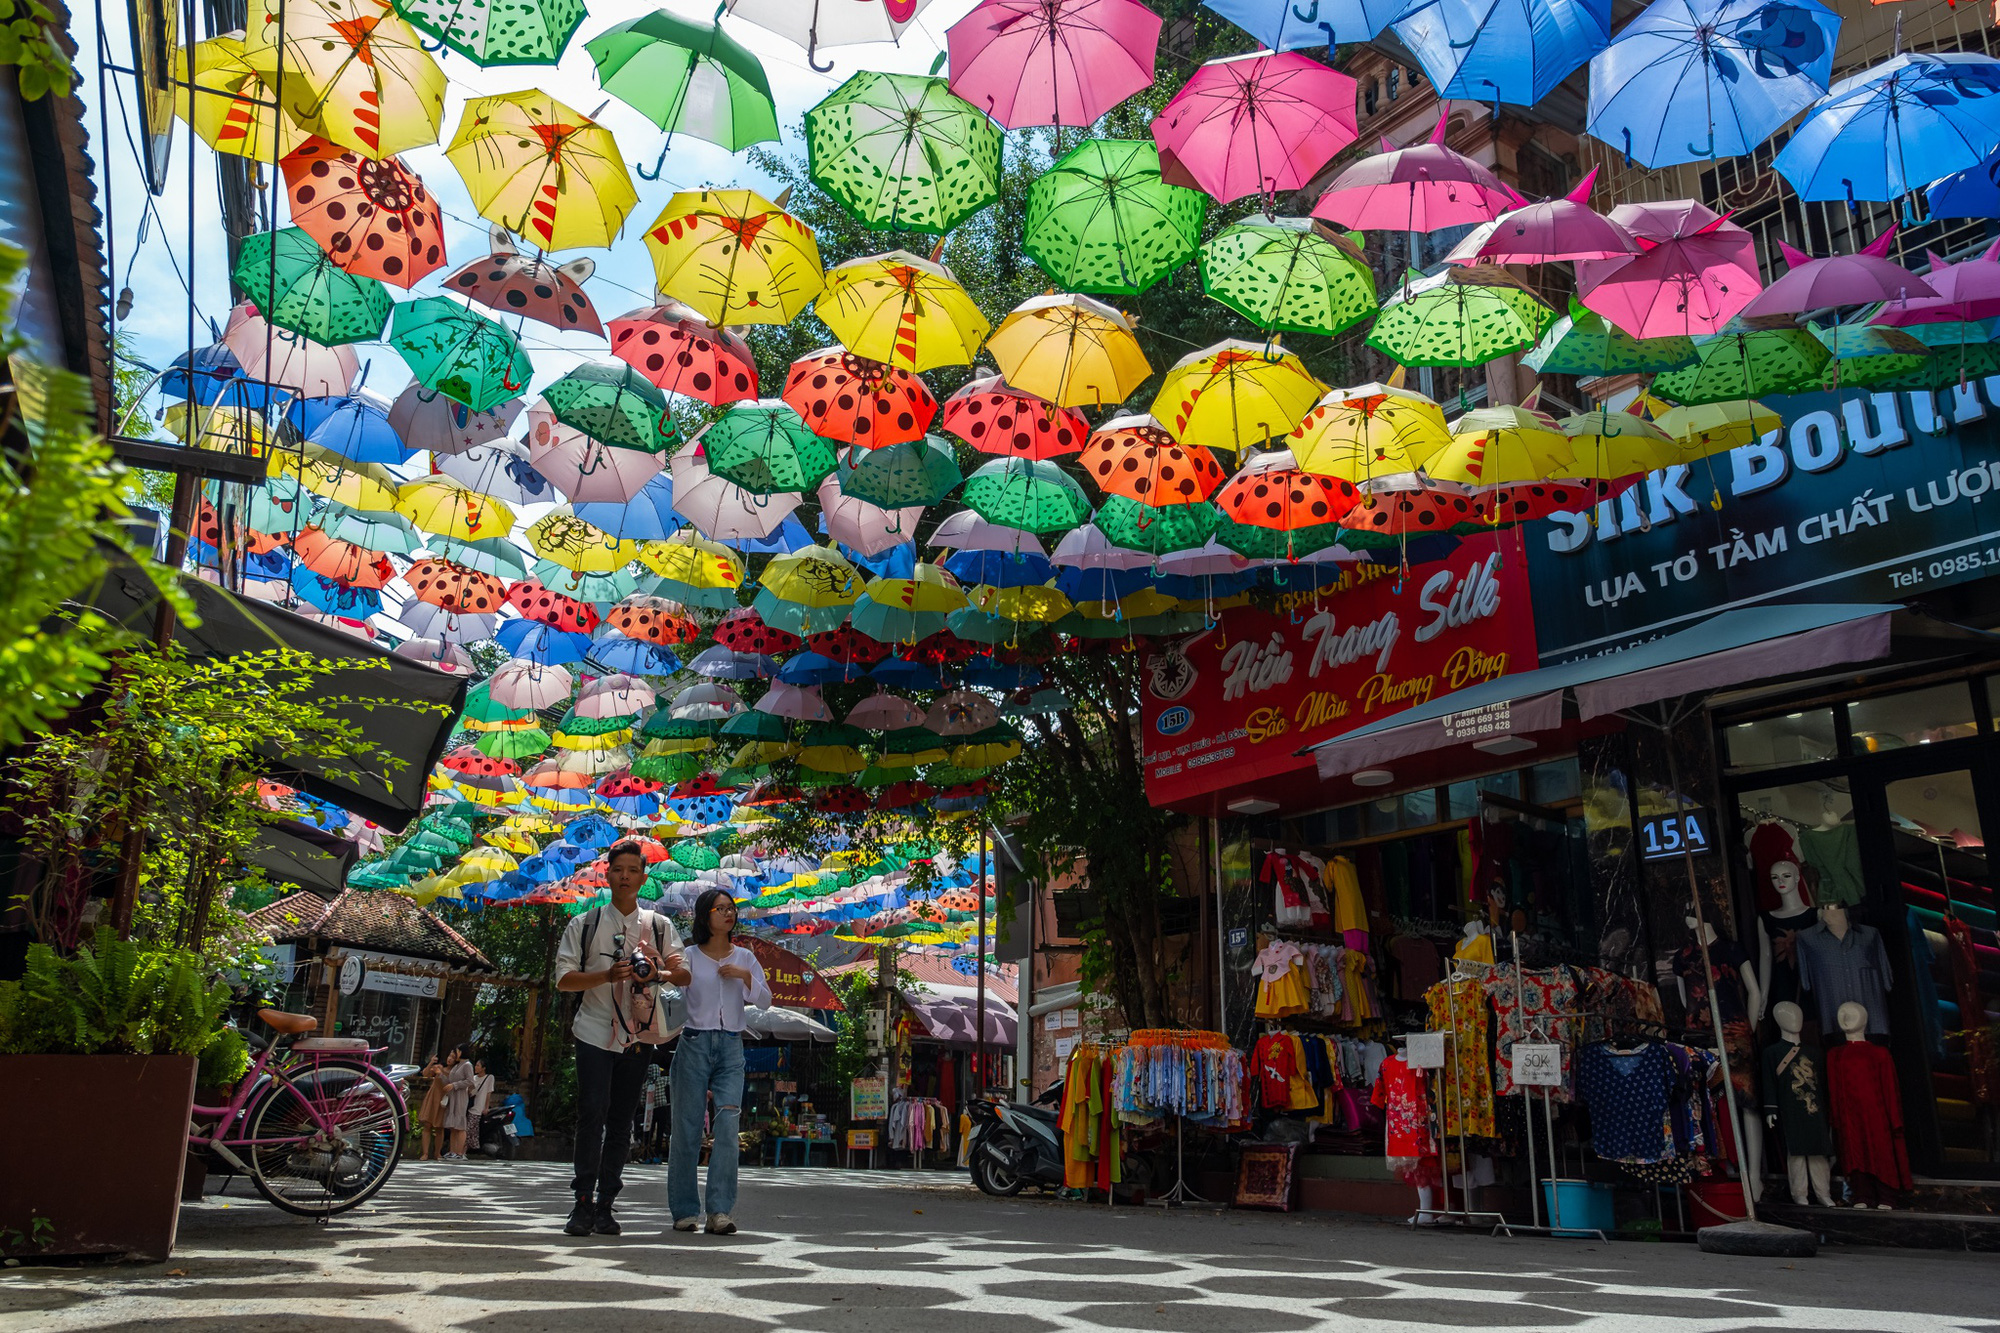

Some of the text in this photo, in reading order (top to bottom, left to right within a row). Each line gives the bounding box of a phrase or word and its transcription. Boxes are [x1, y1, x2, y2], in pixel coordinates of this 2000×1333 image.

[1585, 455, 2000, 608] LỤA TƠ TẰM CHẤT LƯỢ
[1888, 566, 1924, 589] Tel:
[1221, 551, 1502, 701] Hiền Trang Silk
[1245, 646, 1510, 744] Sắc Màu Phương Đông
[1161, 710, 1186, 730] 15B
[1455, 710, 1511, 729] 0936 669 348
[1456, 720, 1511, 738] 0936 669 428
[1643, 815, 1706, 853] 15A
[775, 968, 802, 987] Lụa
[346, 1013, 367, 1027] Trà
[1523, 1053, 1550, 1069] 50K
